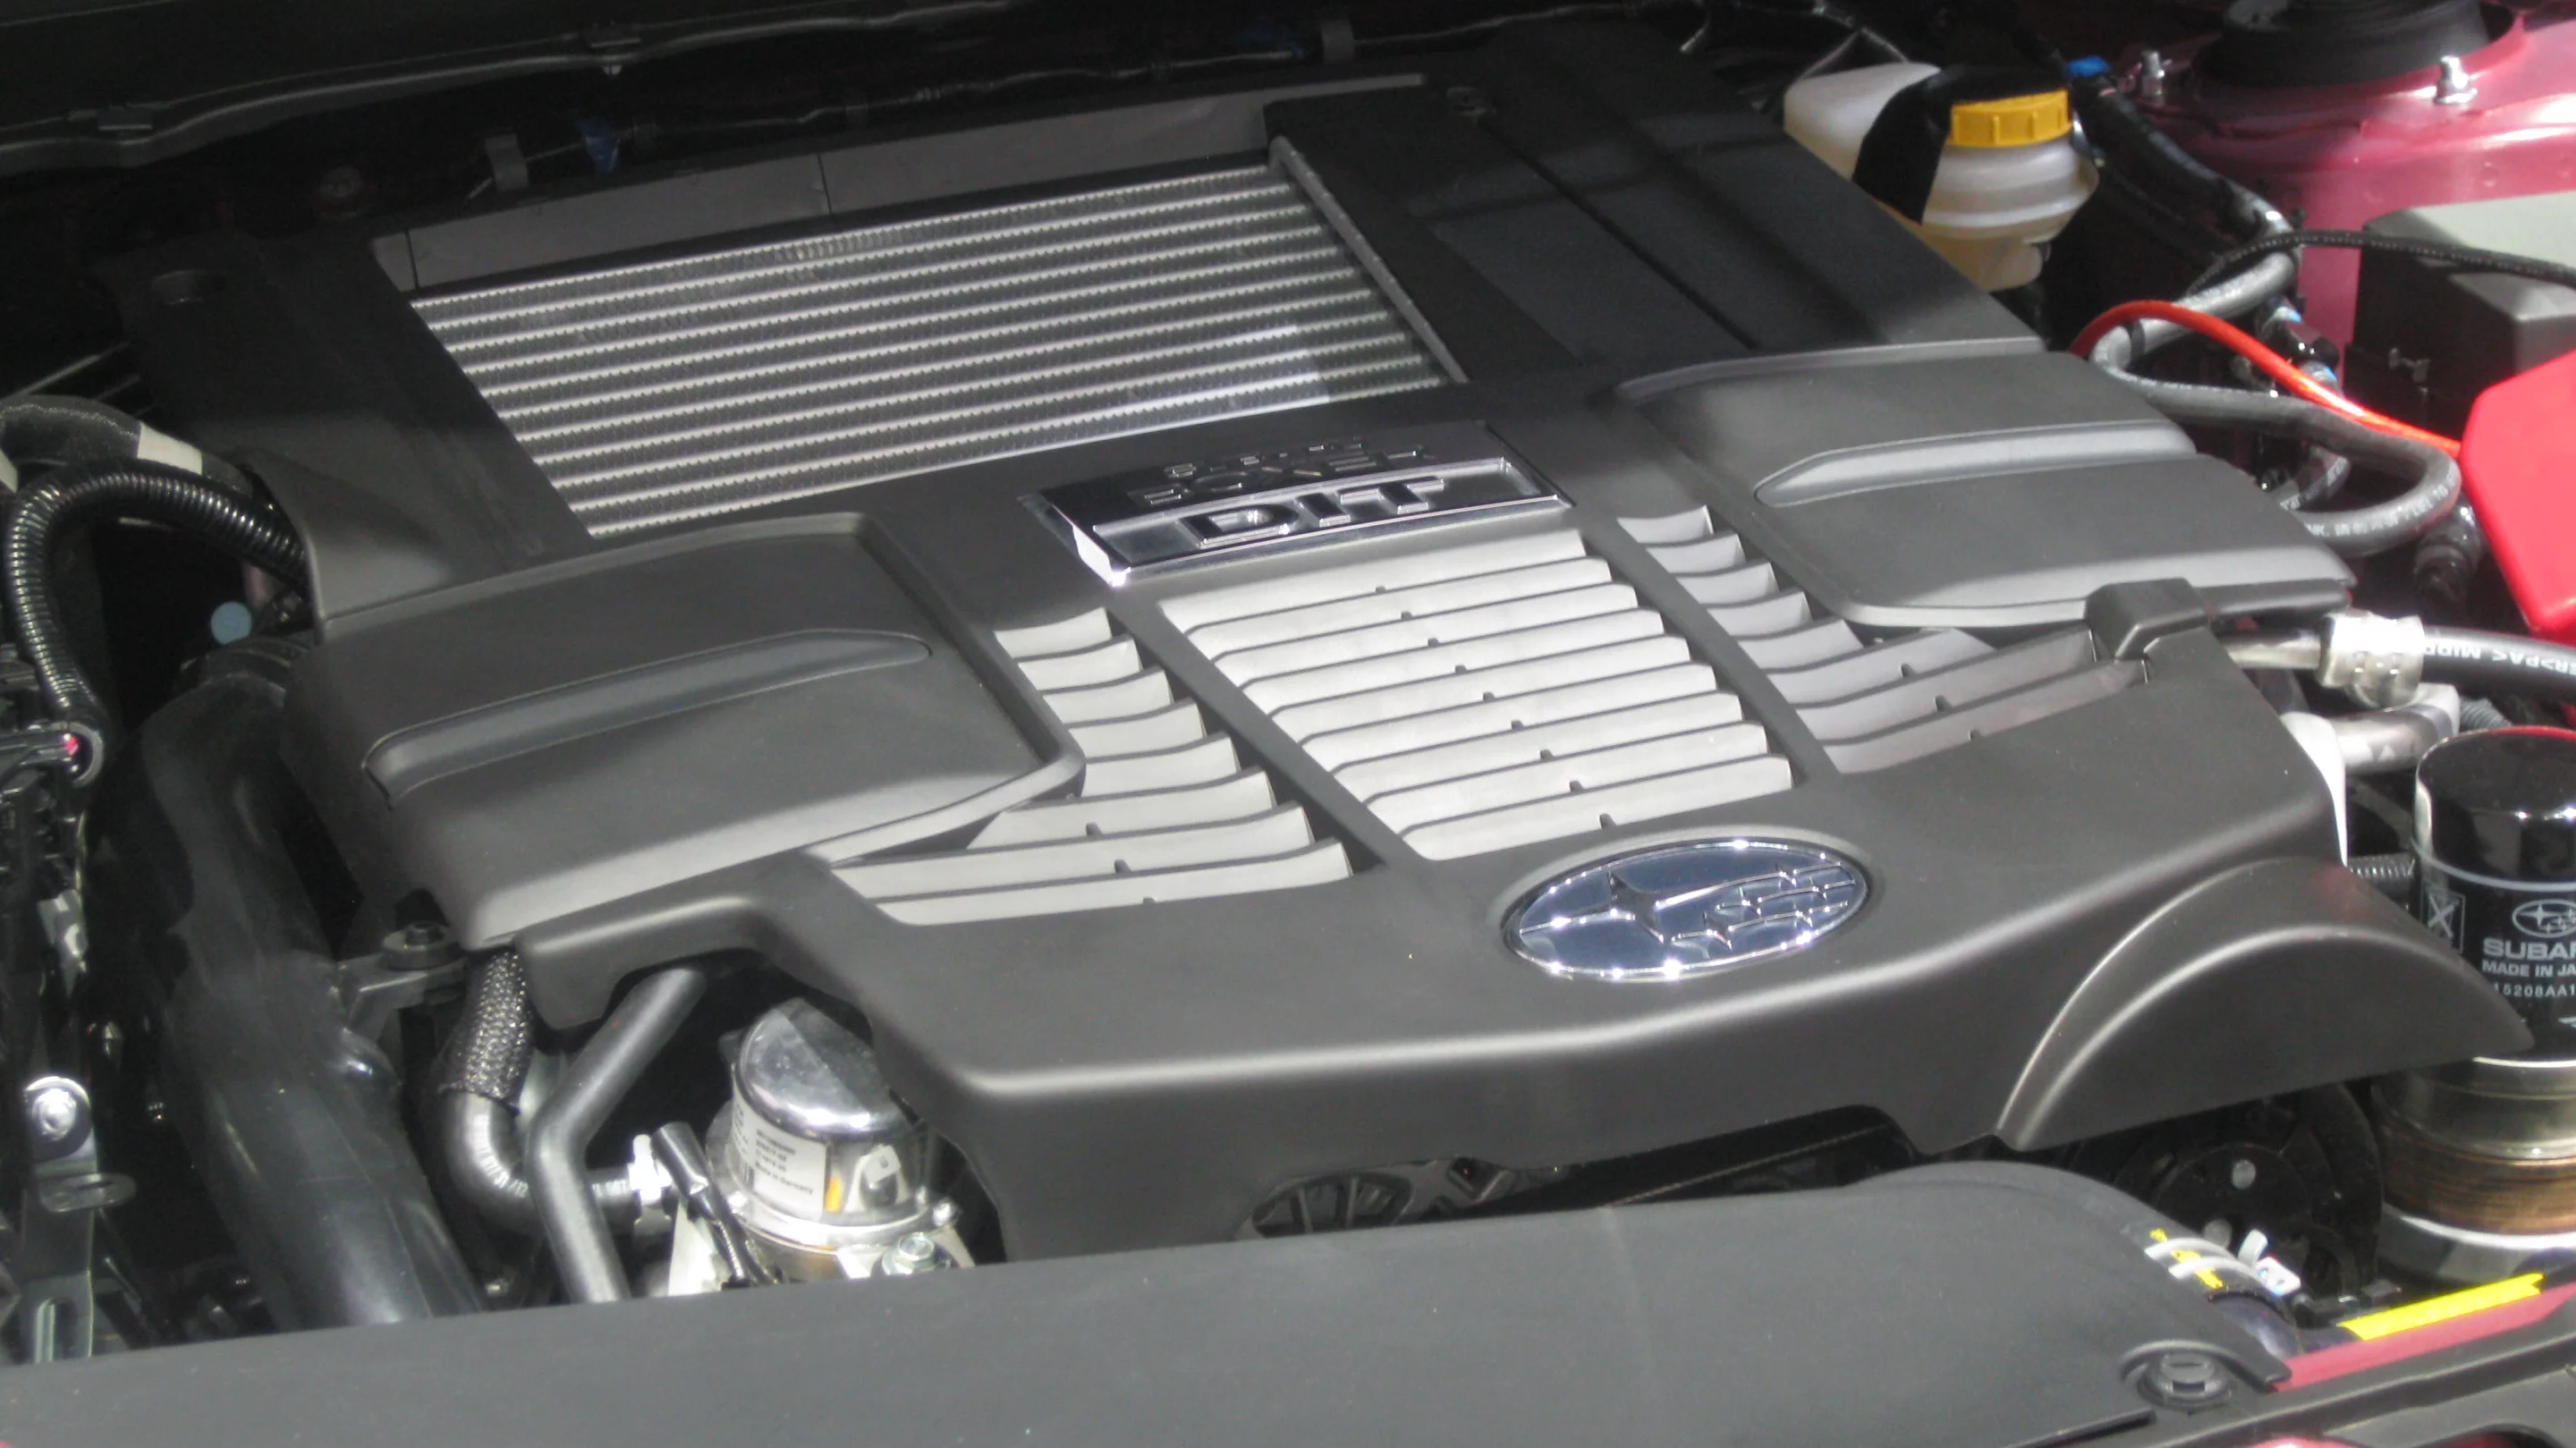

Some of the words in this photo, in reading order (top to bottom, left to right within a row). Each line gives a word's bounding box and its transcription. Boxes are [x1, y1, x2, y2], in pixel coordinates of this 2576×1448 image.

[1177, 474, 1445, 549] DIT
[2482, 961, 2529, 977] MADE
[2535, 964, 2554, 978] IN
